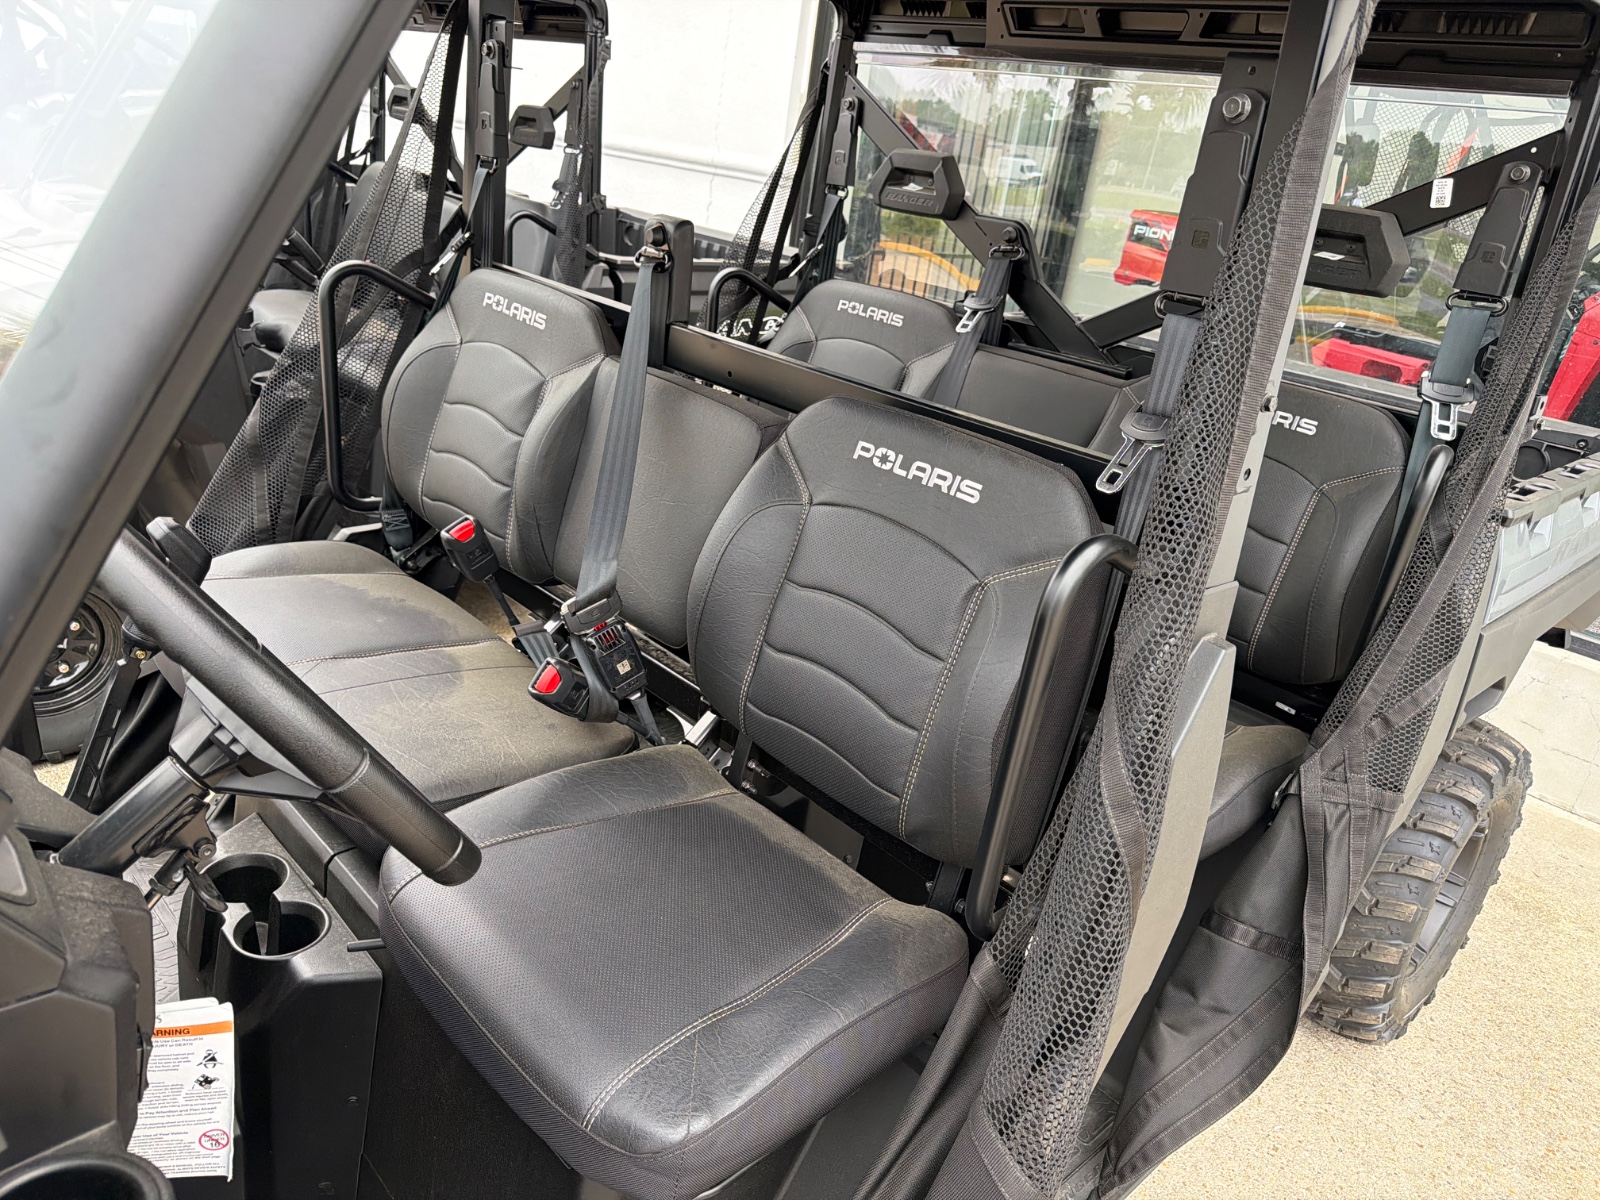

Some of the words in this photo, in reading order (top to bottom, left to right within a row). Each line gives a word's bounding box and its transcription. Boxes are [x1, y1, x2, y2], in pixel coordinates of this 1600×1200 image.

[885, 192, 933, 206] RANGER
[482, 292, 547, 330] POLARIS
[837, 299, 905, 328] POLARIS
[852, 440, 983, 504] POLARIS
